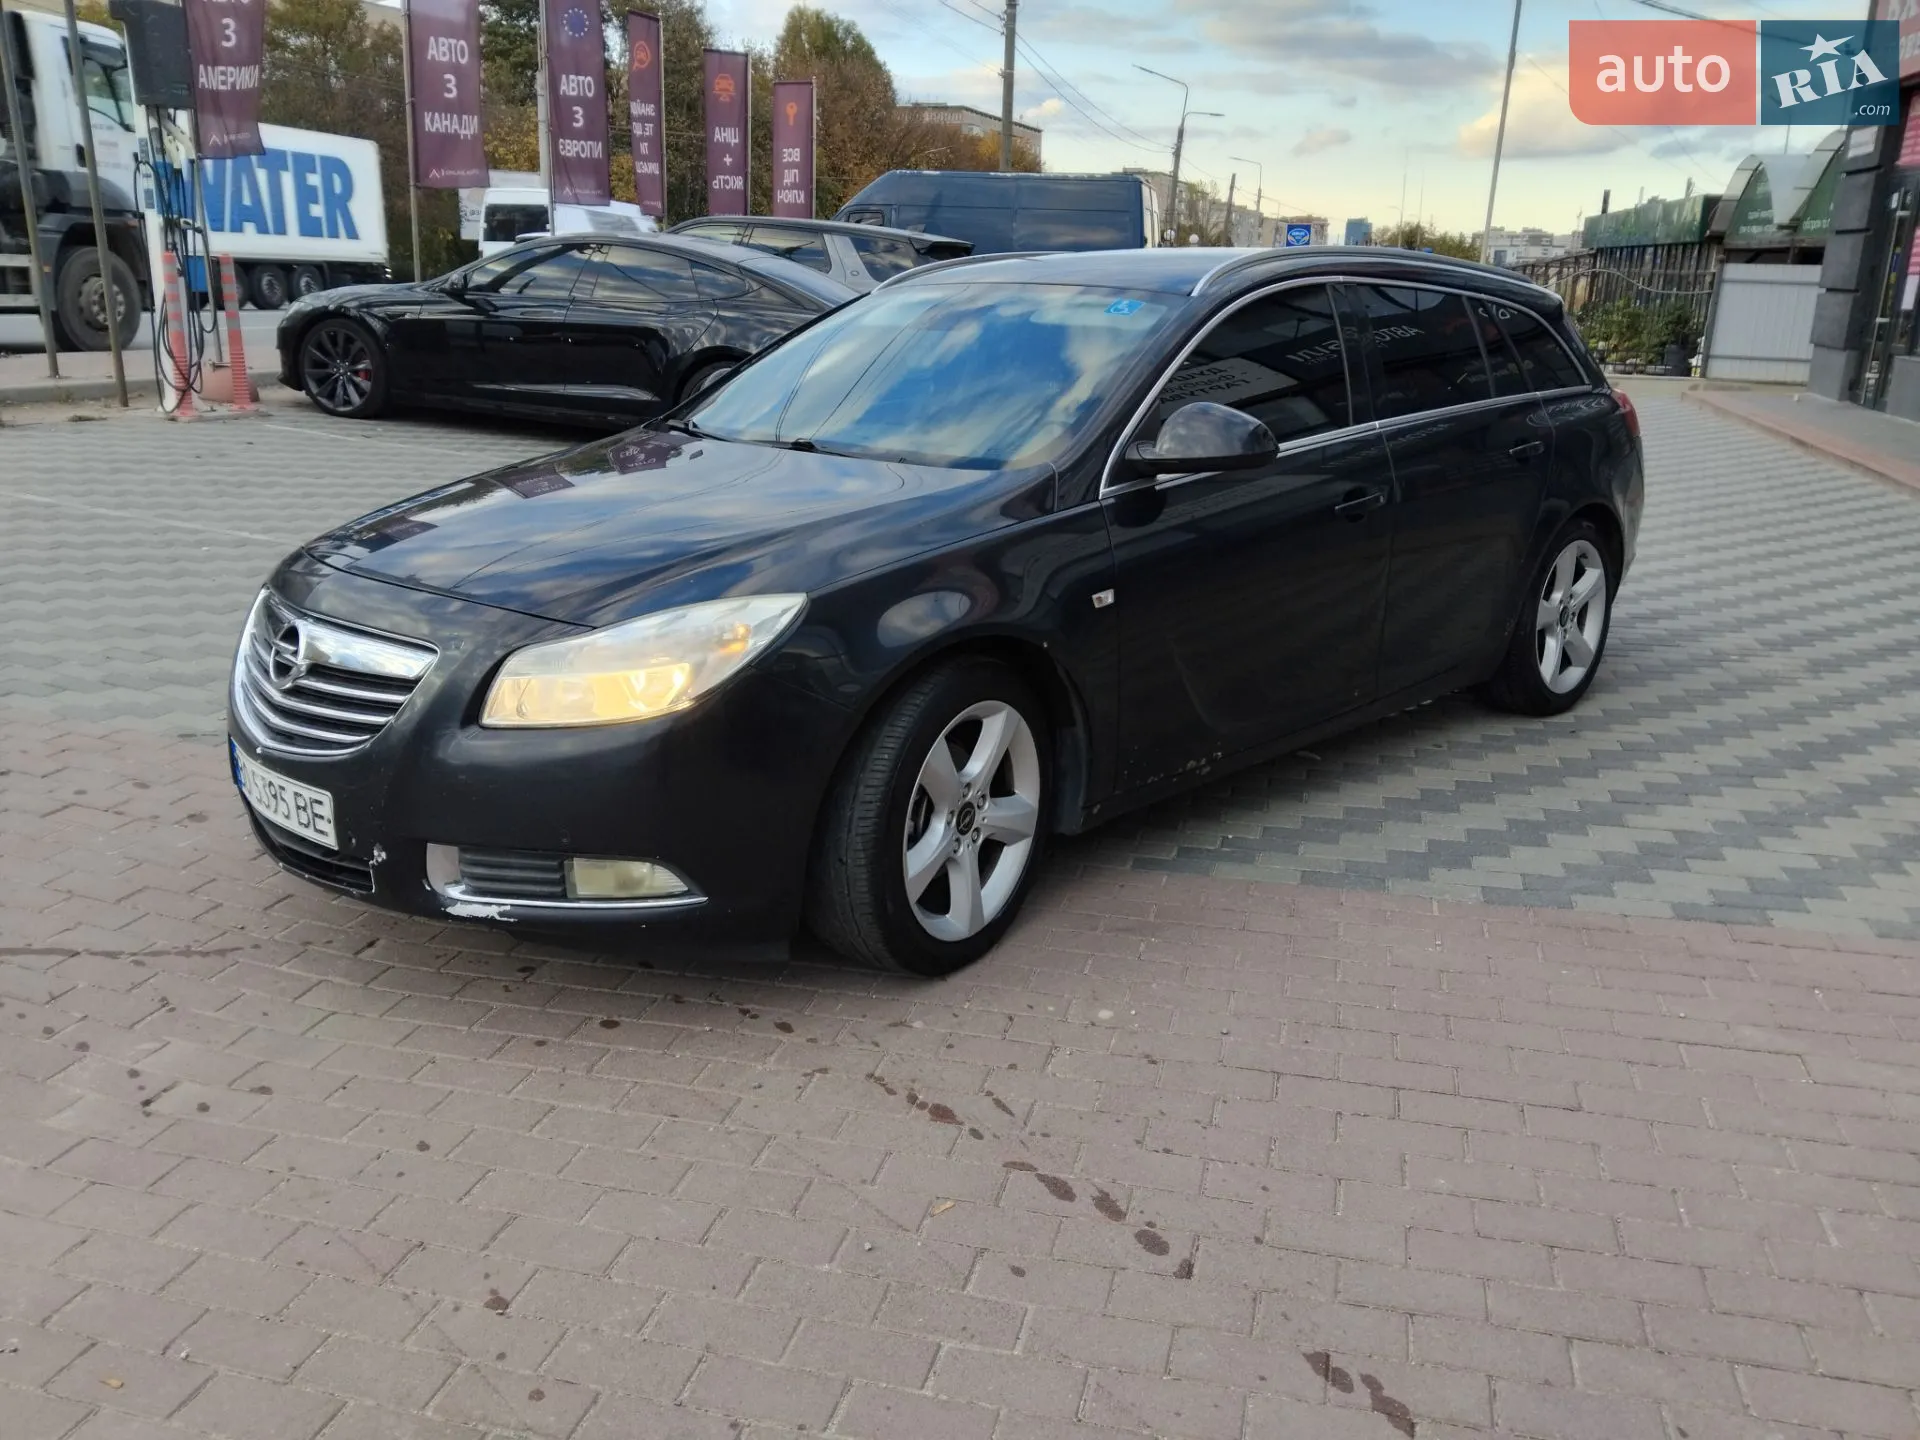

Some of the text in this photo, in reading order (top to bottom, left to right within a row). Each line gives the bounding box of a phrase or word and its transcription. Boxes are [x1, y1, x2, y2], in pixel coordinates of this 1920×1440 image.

[427, 35, 469, 65] АВТО
[198, 63, 260, 92] АМЕРИКИ
[560, 74, 596, 98] АВТО
[424, 111, 479, 140] КАНАДИ
[558, 138, 603, 159] ЄВРОПИ
[293, 790, 330, 838] BE
